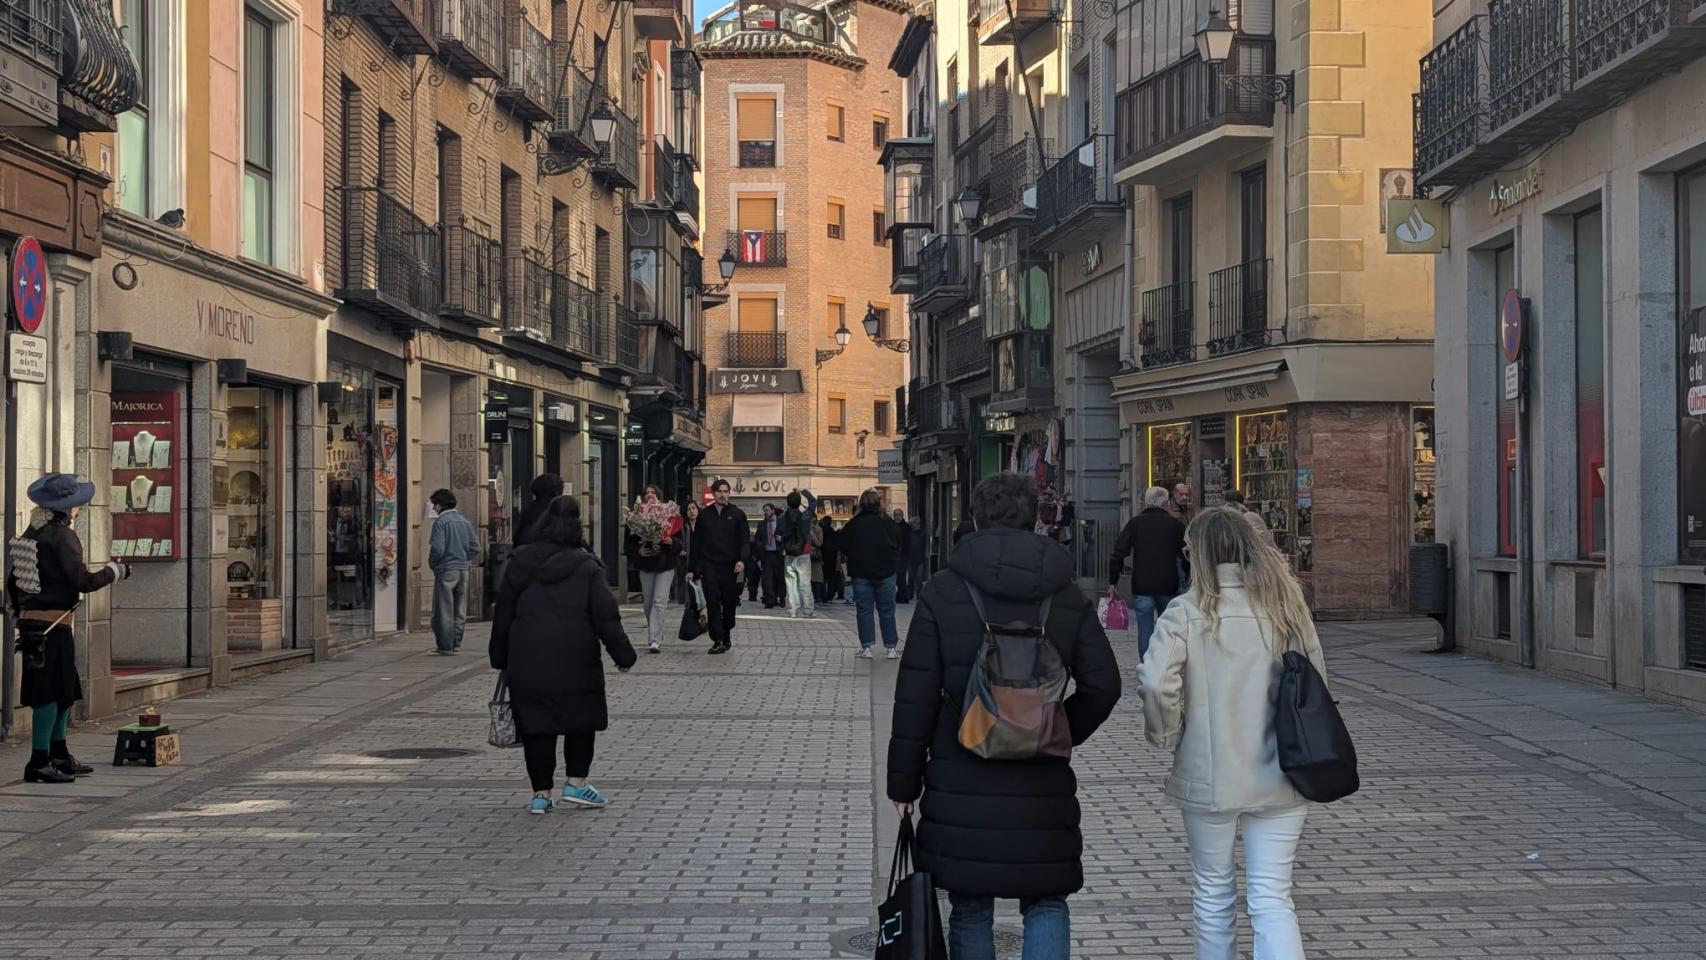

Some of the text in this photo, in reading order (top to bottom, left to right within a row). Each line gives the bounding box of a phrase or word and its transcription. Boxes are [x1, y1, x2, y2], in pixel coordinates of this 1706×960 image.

[1498, 167, 1544, 210] Santander
[732, 374, 766, 383] JOVI
[1695, 360, 1703, 380] la
[1224, 382, 1269, 402] CORK SPAIN
[1137, 397, 1175, 414] CORK SPAIN
[752, 479, 785, 493] JOVI
